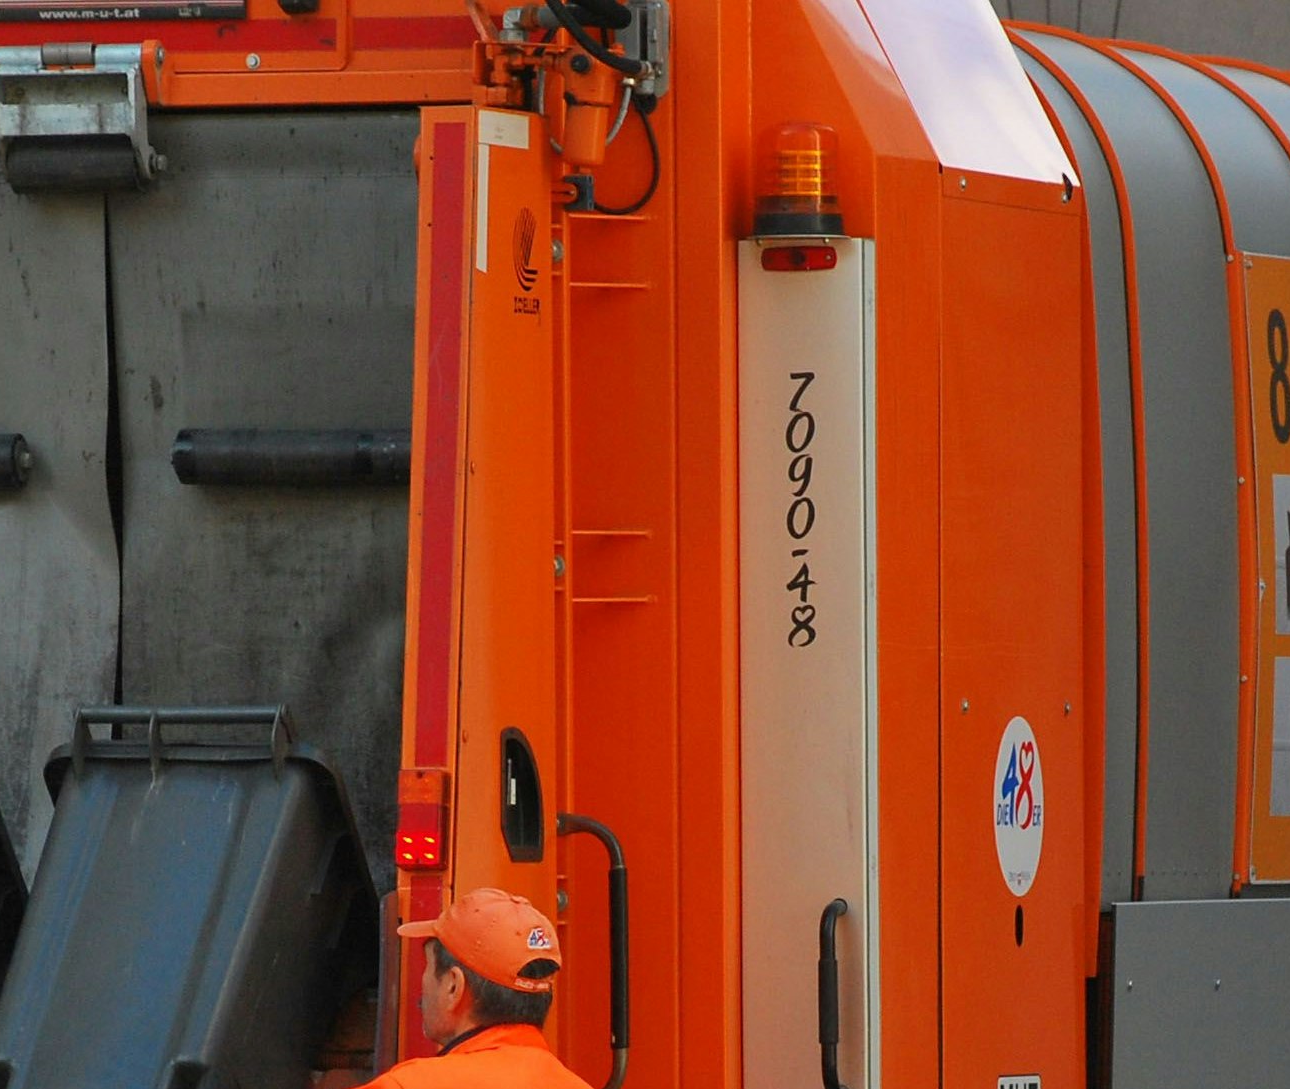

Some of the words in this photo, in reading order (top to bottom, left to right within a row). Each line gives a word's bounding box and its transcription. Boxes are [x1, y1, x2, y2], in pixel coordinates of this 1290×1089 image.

[39, 8, 141, 19] www.m-u-t.at
[785, 371, 817, 648] 7090-48
[1002, 741, 1036, 830] 48
[996, 804, 1009, 826] DIE
